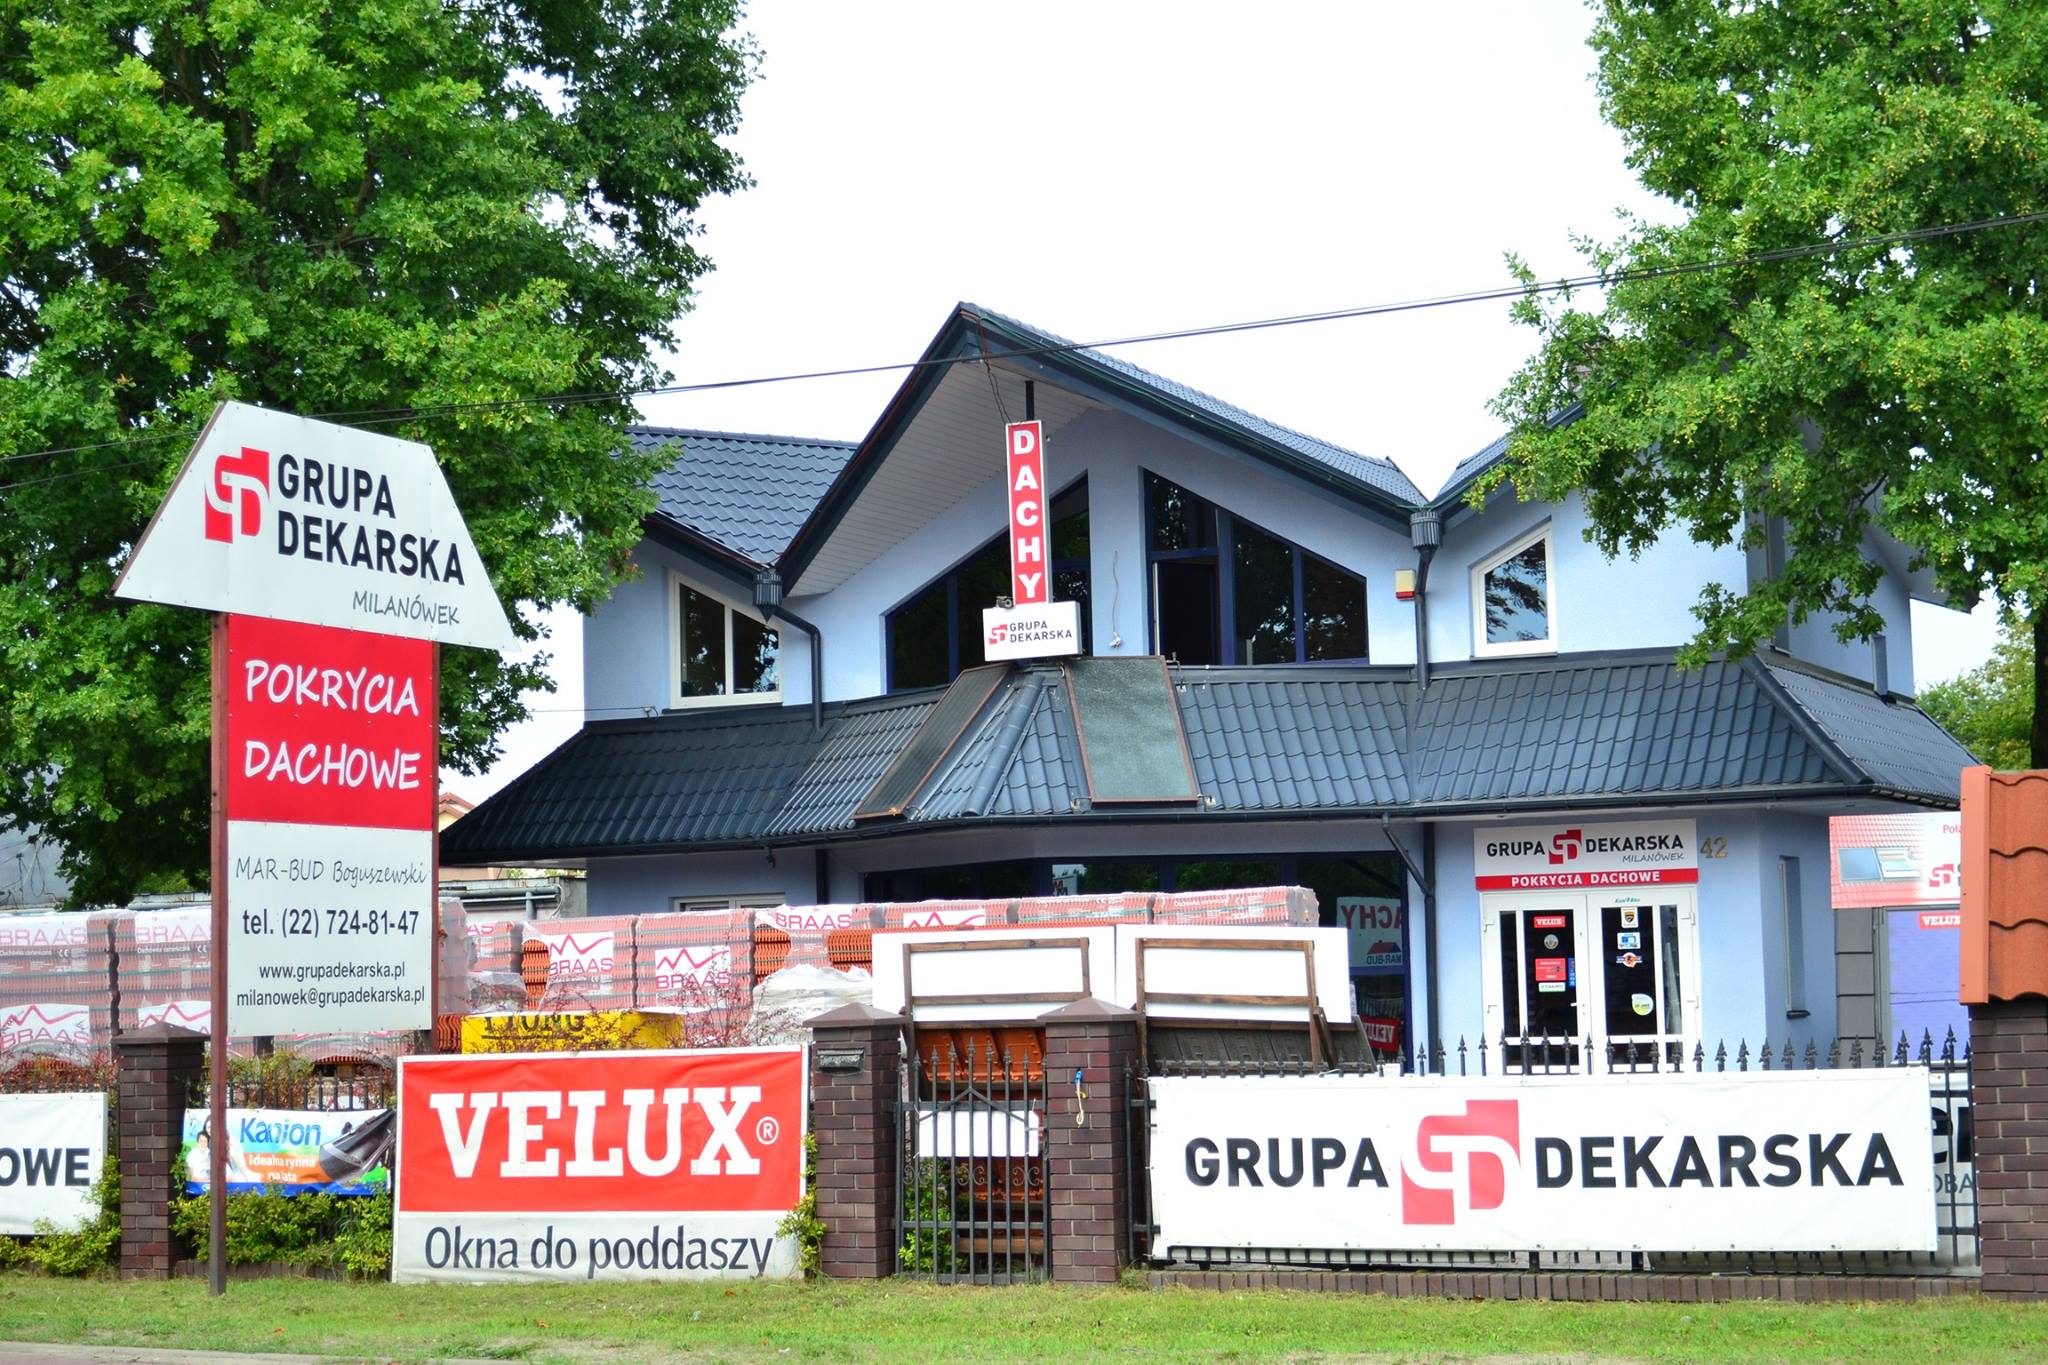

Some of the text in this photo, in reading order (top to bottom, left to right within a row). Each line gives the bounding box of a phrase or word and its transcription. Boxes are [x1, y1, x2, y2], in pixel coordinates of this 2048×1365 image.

[277, 453, 396, 519] GRUPA
[1013, 430, 1042, 599] DACHY
[278, 510, 465, 586] DEKARSKA
[352, 590, 461, 626] MILANÓWEK
[1009, 621, 1048, 632] GRUPA
[1010, 629, 1073, 643] DEKARSKA
[244, 659, 420, 716] POKRYCIA
[244, 740, 421, 790] DACHOWE
[1486, 835, 1684, 857] GRUPA DEKARSKA
[1622, 851, 1685, 863] MILANÓWEK
[1700, 836, 1728, 859] 42
[235, 856, 428, 888] MAR-BUD Boguszewski
[1511, 871, 1660, 888] POKRYCIA DACHOWE
[242, 908, 419, 938] tel. (22) 724-81-47
[776, 914, 850, 930] BRAAS
[0, 928, 87, 946] BRAAS
[135, 925, 210, 943] BRAA
[259, 961, 405, 983] www.grupadekarska.pl
[550, 958, 613, 976] BRAAS
[237, 986, 425, 1008] milanowek@grupadekarska.pl
[240, 1118, 321, 1146] Kanion
[249, 1154, 316, 1169] Idealna rynna
[1185, 1136, 1389, 1189] GRUPA
[1535, 1132, 1906, 1189] DEKARSKA
[425, 1224, 774, 1279] Okna do poddaszy
